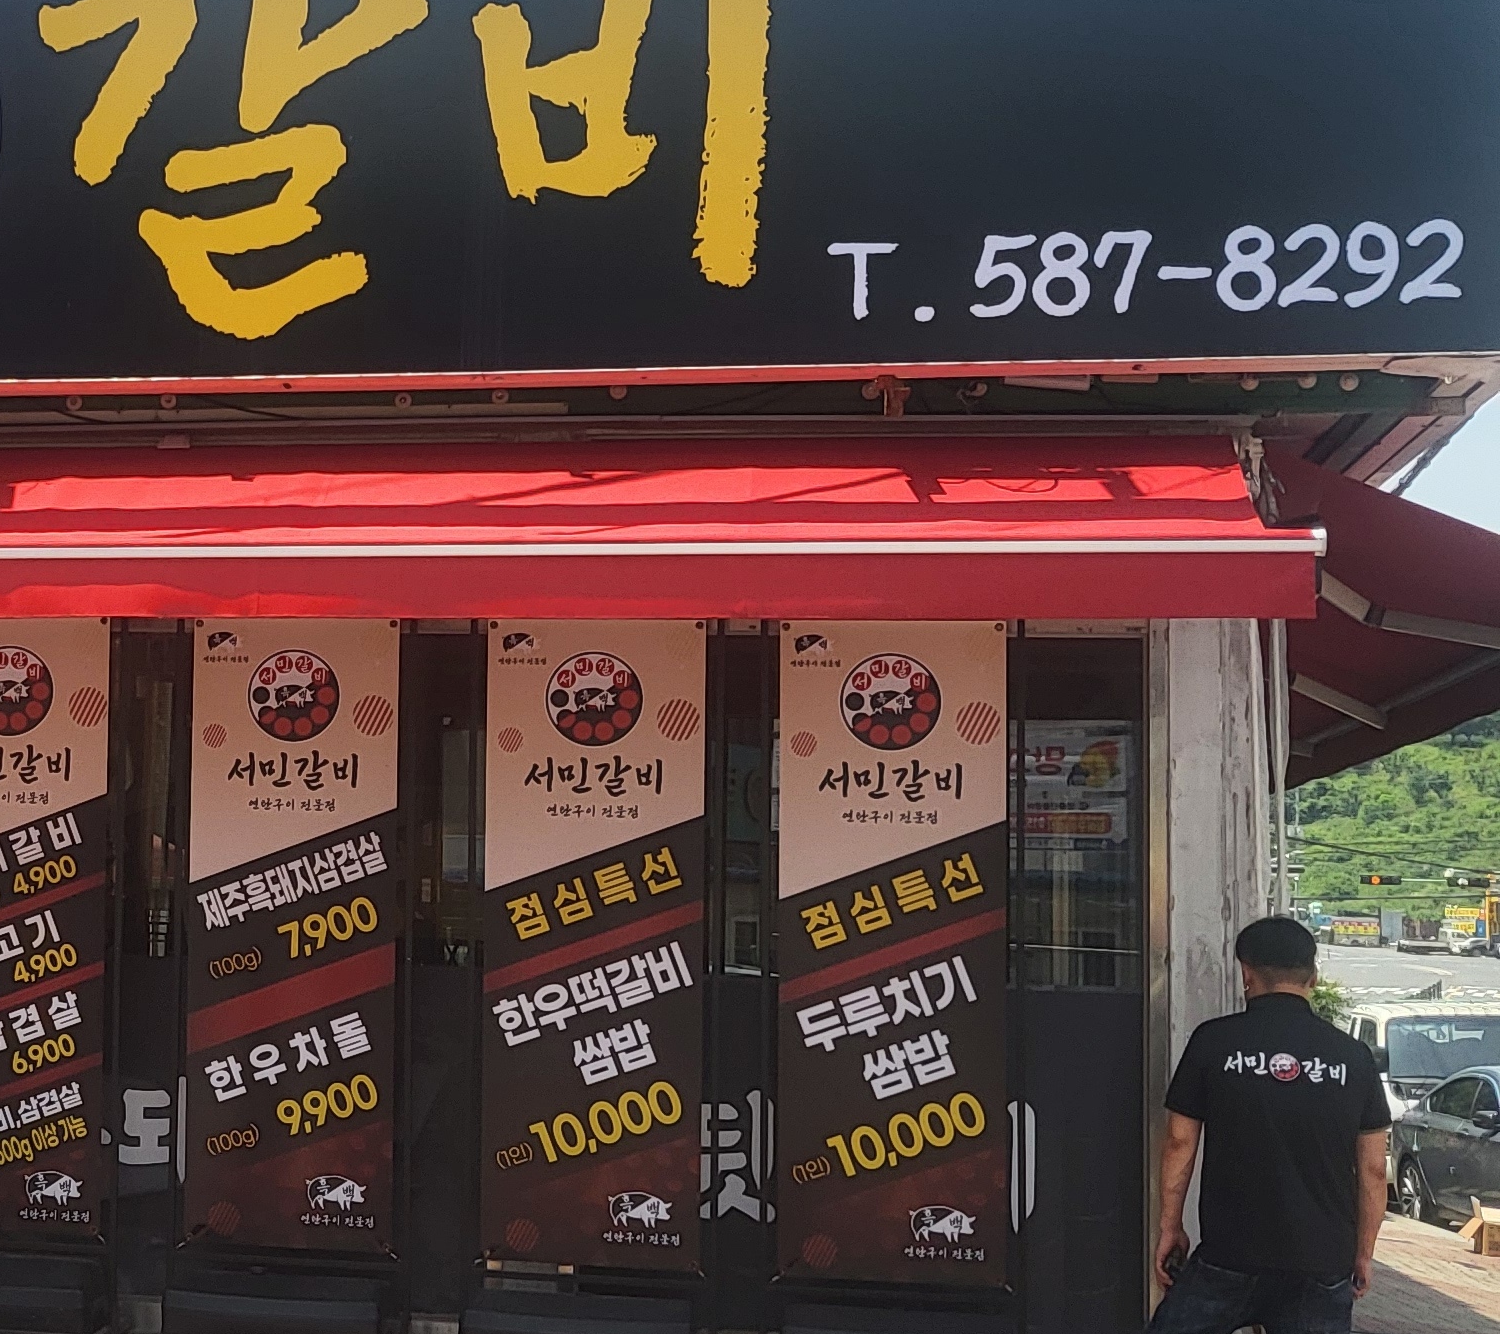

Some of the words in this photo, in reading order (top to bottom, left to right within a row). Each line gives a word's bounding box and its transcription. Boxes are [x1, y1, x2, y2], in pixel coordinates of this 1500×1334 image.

[969, 218, 1465, 319] 587-8292
[227, 749, 360, 792] 서민갈비
[524, 755, 663, 798] 서민갈비
[818, 759, 963, 802] 서민갈비
[12, 854, 77, 896] 4,900
[196, 830, 389, 933] 제주흑돼지삼겹살
[505, 846, 684, 942] 점심특선
[800, 852, 985, 951] 점심특선
[13, 943, 78, 984] 4,900
[208, 946, 263, 980] (100g)
[276, 896, 379, 960] 7,900
[492, 940, 695, 1048] 한우떡갈비
[795, 954, 979, 1053] 두루치기
[11, 1033, 76, 1075] 6,900
[203, 1011, 372, 1103] 한우차돌
[572, 1018, 658, 1086] 쌈밥
[862, 1029, 958, 1101] 쌈밥
[1223, 1049, 1269, 1075] 서민
[1300, 1056, 1348, 1086] 갈비
[30, 1126, 60, 1153] 이상
[60, 1114, 89, 1143] 가능
[205, 1122, 260, 1157] (100g)
[275, 1073, 379, 1137] 9,900
[529, 1080, 683, 1164] 10,000
[826, 1092, 986, 1178] 10,000
